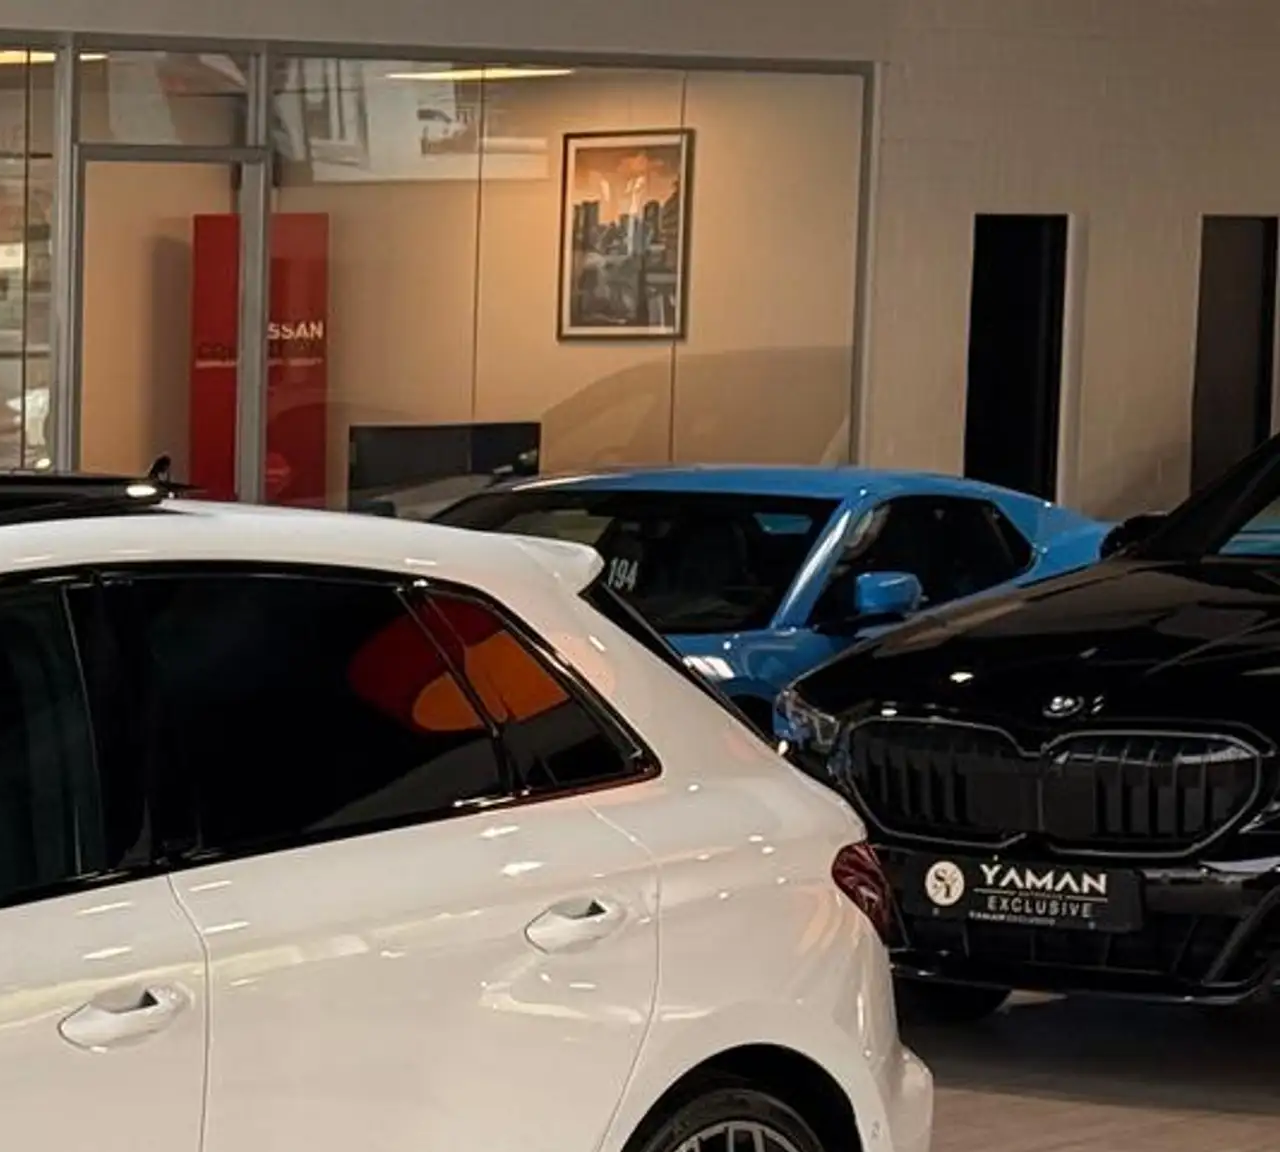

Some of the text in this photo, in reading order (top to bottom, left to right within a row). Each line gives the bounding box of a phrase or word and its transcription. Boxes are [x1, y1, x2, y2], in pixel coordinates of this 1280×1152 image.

[267, 320, 324, 340] SSAN
[608, 556, 639, 592] 194
[980, 864, 1107, 895] YAMAN
[987, 895, 1093, 918] EXCLUSIVE
